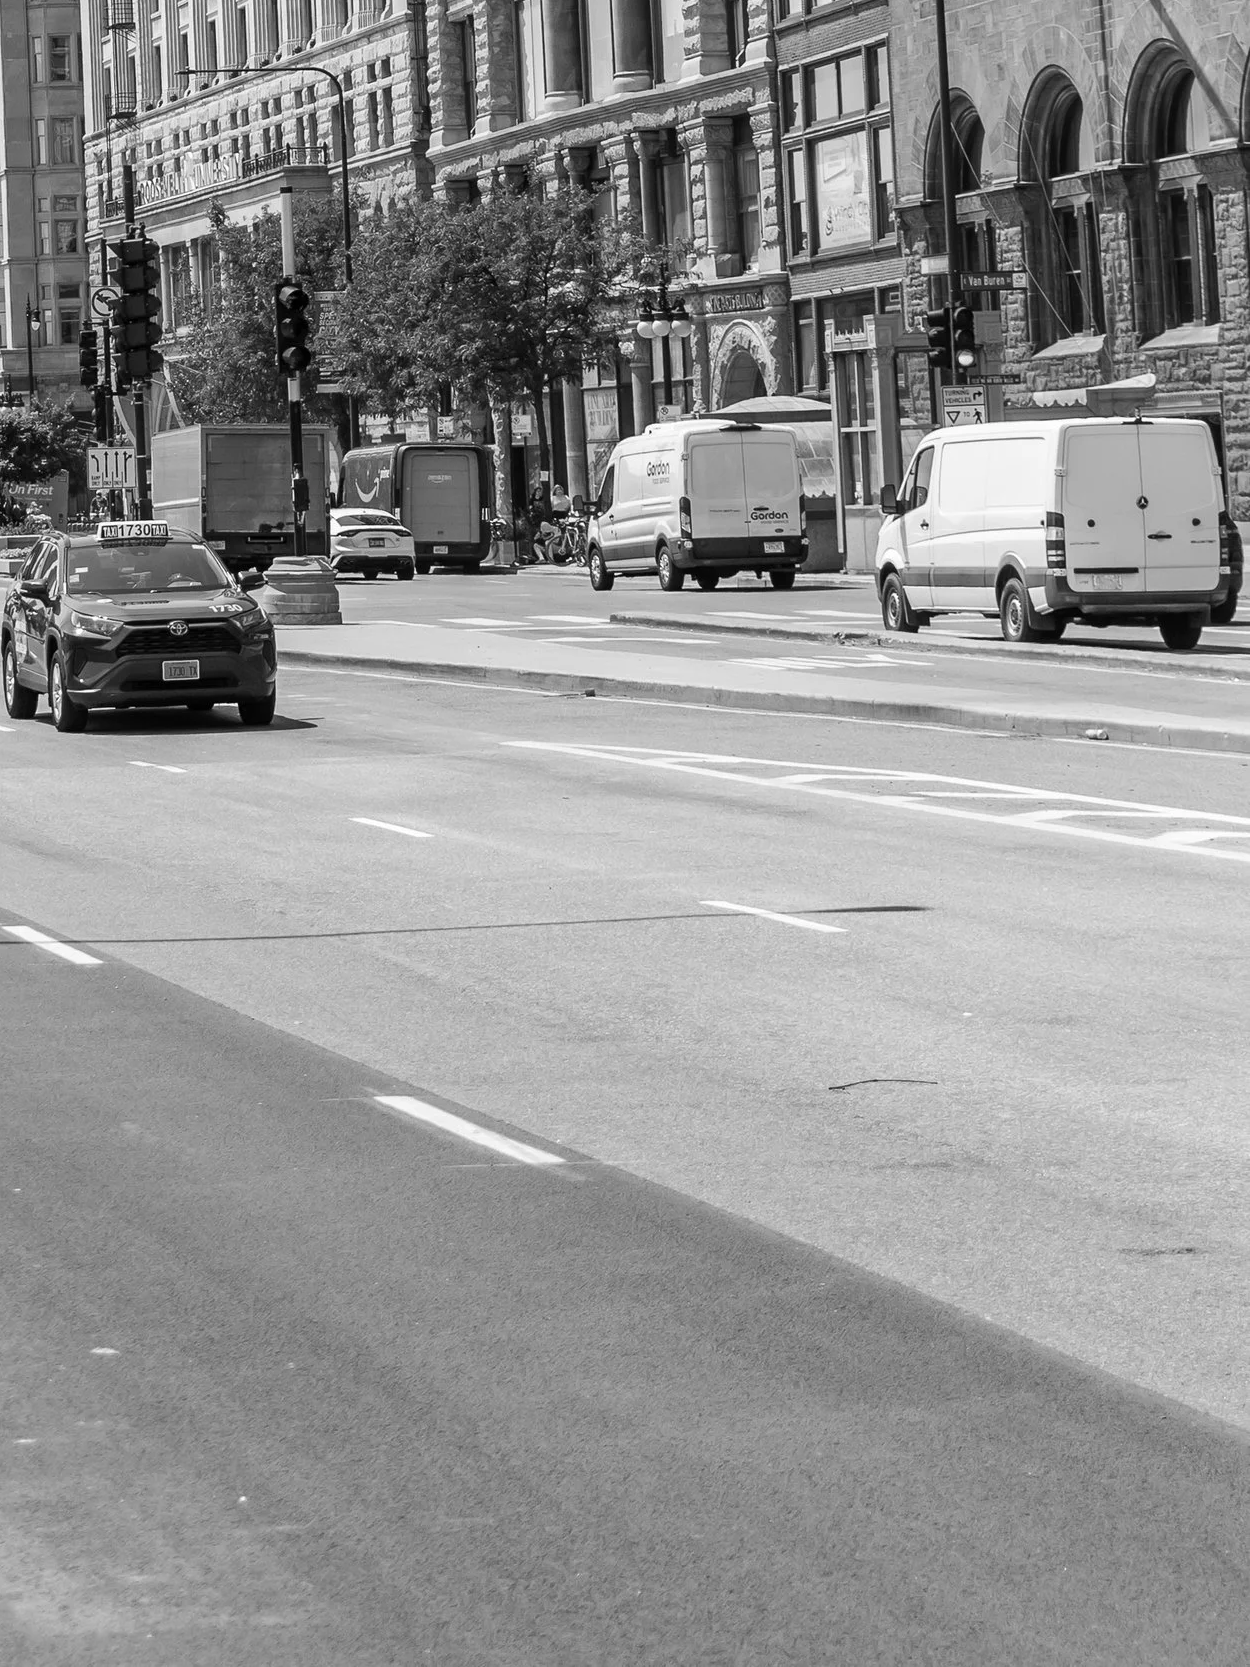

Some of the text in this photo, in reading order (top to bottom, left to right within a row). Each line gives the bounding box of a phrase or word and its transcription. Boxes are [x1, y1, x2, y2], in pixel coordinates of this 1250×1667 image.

[193, 150, 243, 189] UNIVERSITY
[968, 276, 982, 286] Van
[983, 275, 1005, 286] Buren
[945, 389, 970, 397] TURNING
[646, 462, 670, 477] Gordon
[27, 484, 54, 496] First
[750, 511, 789, 521] Gordon
[103, 523, 167, 538] TAXI 1730 TAXI
[209, 603, 244, 613] 1730
[169, 665, 198, 677] 1730 TX
